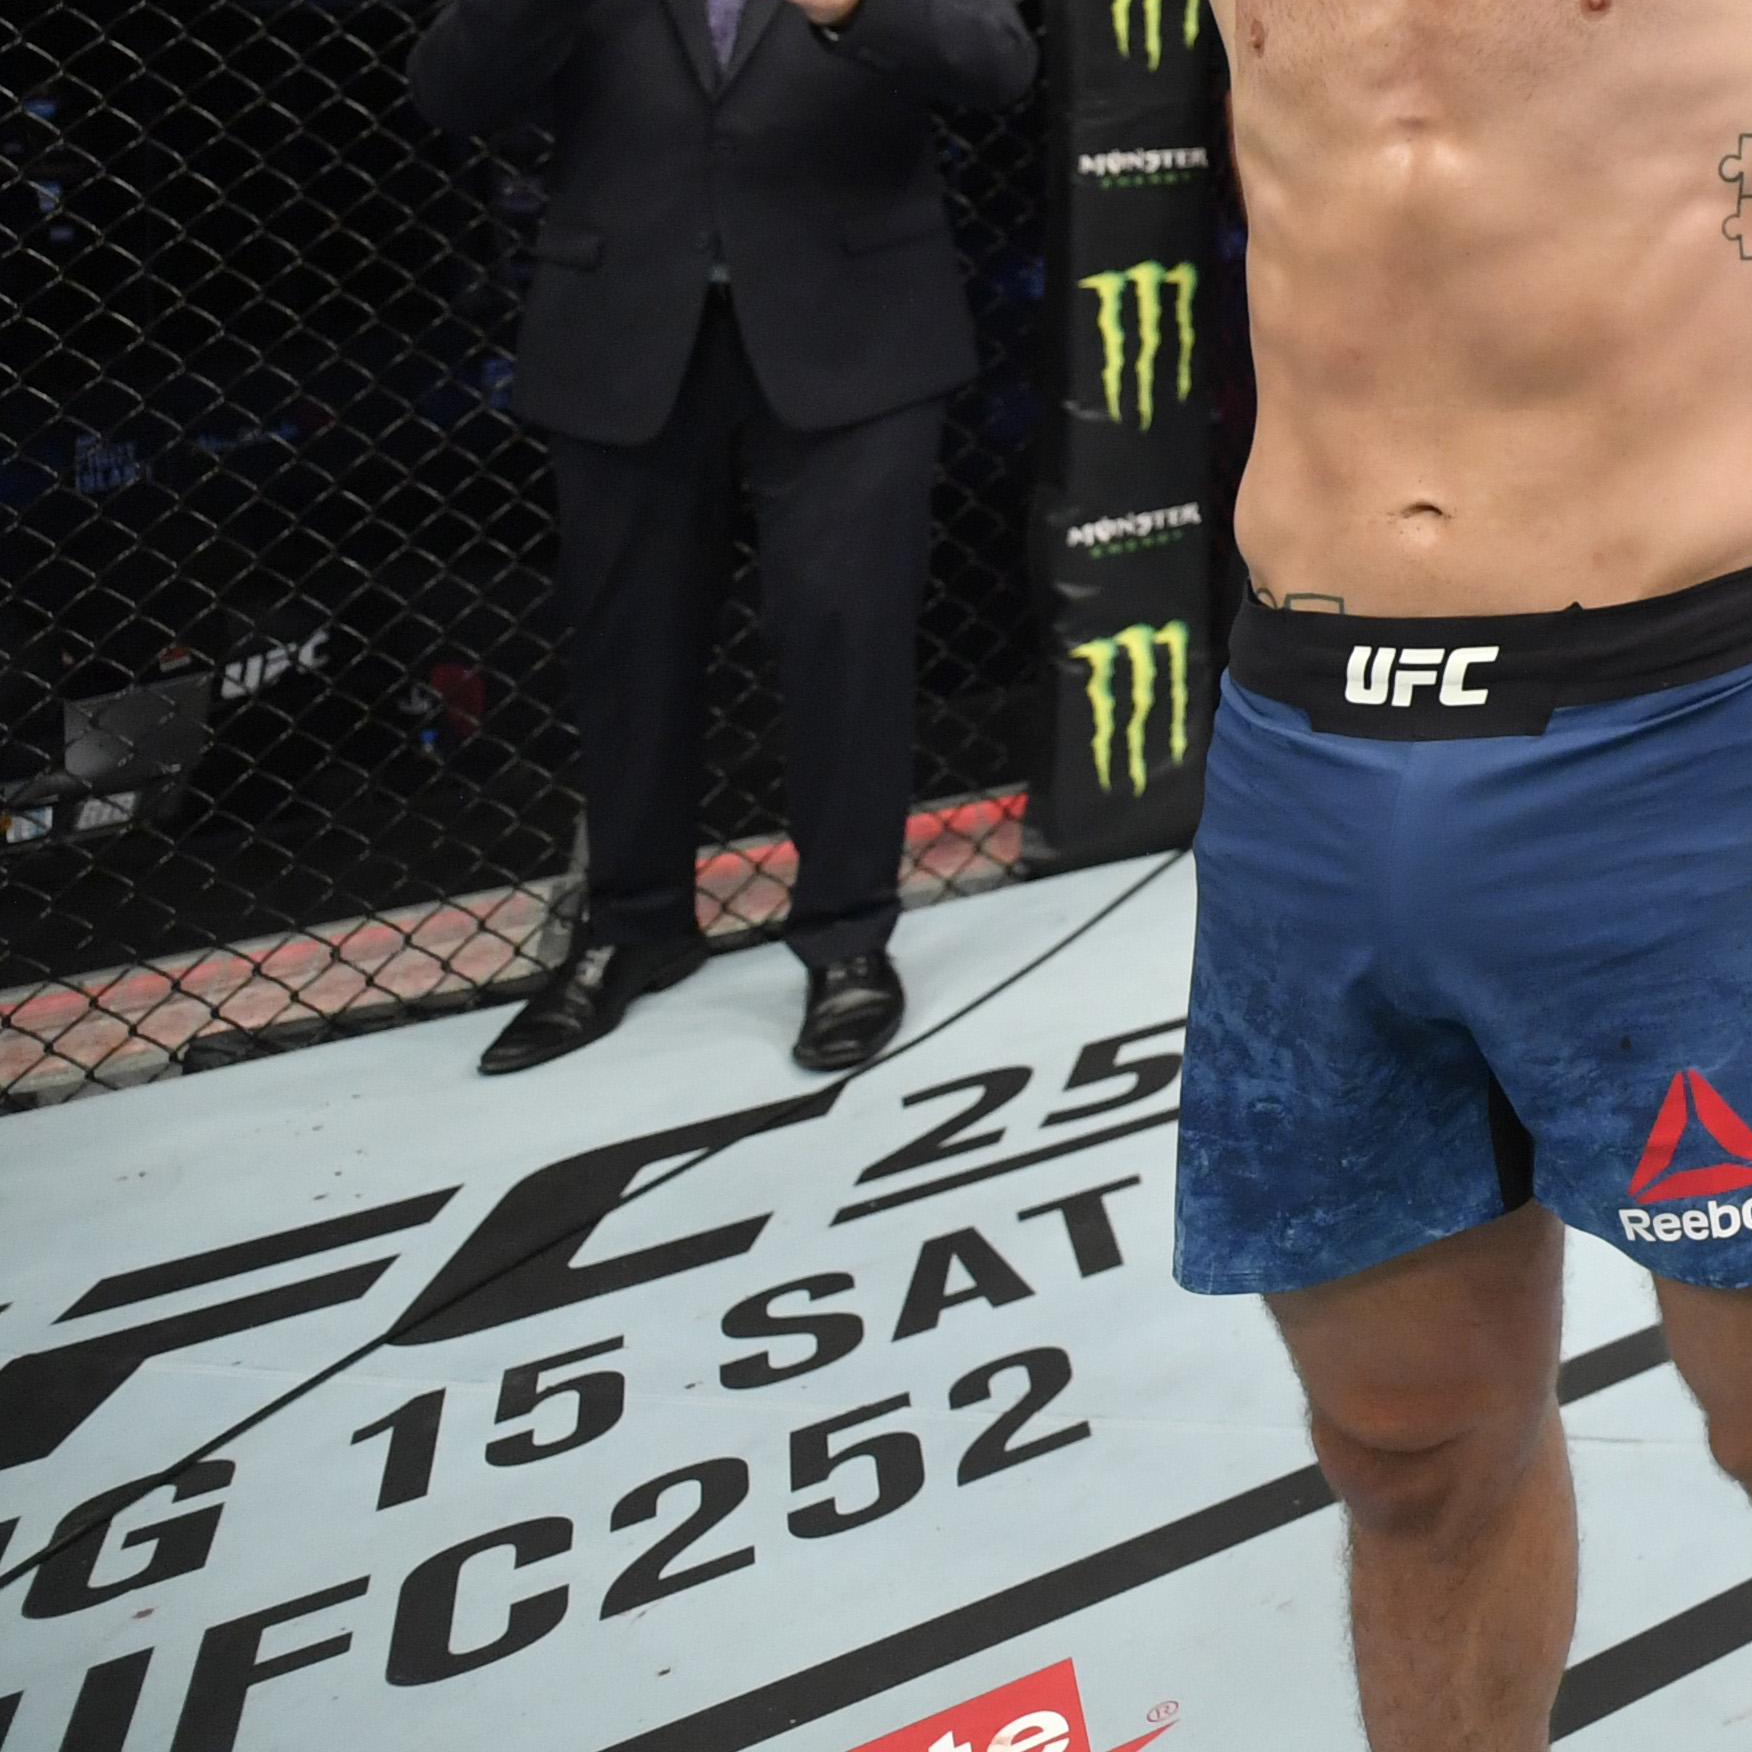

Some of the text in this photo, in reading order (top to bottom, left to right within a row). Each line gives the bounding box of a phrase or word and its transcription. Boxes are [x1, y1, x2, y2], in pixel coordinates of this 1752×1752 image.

[1345, 645, 1500, 707] UFC
[350, 1336, 625, 1512] 15
[719, 1174, 1142, 1391] SAT
